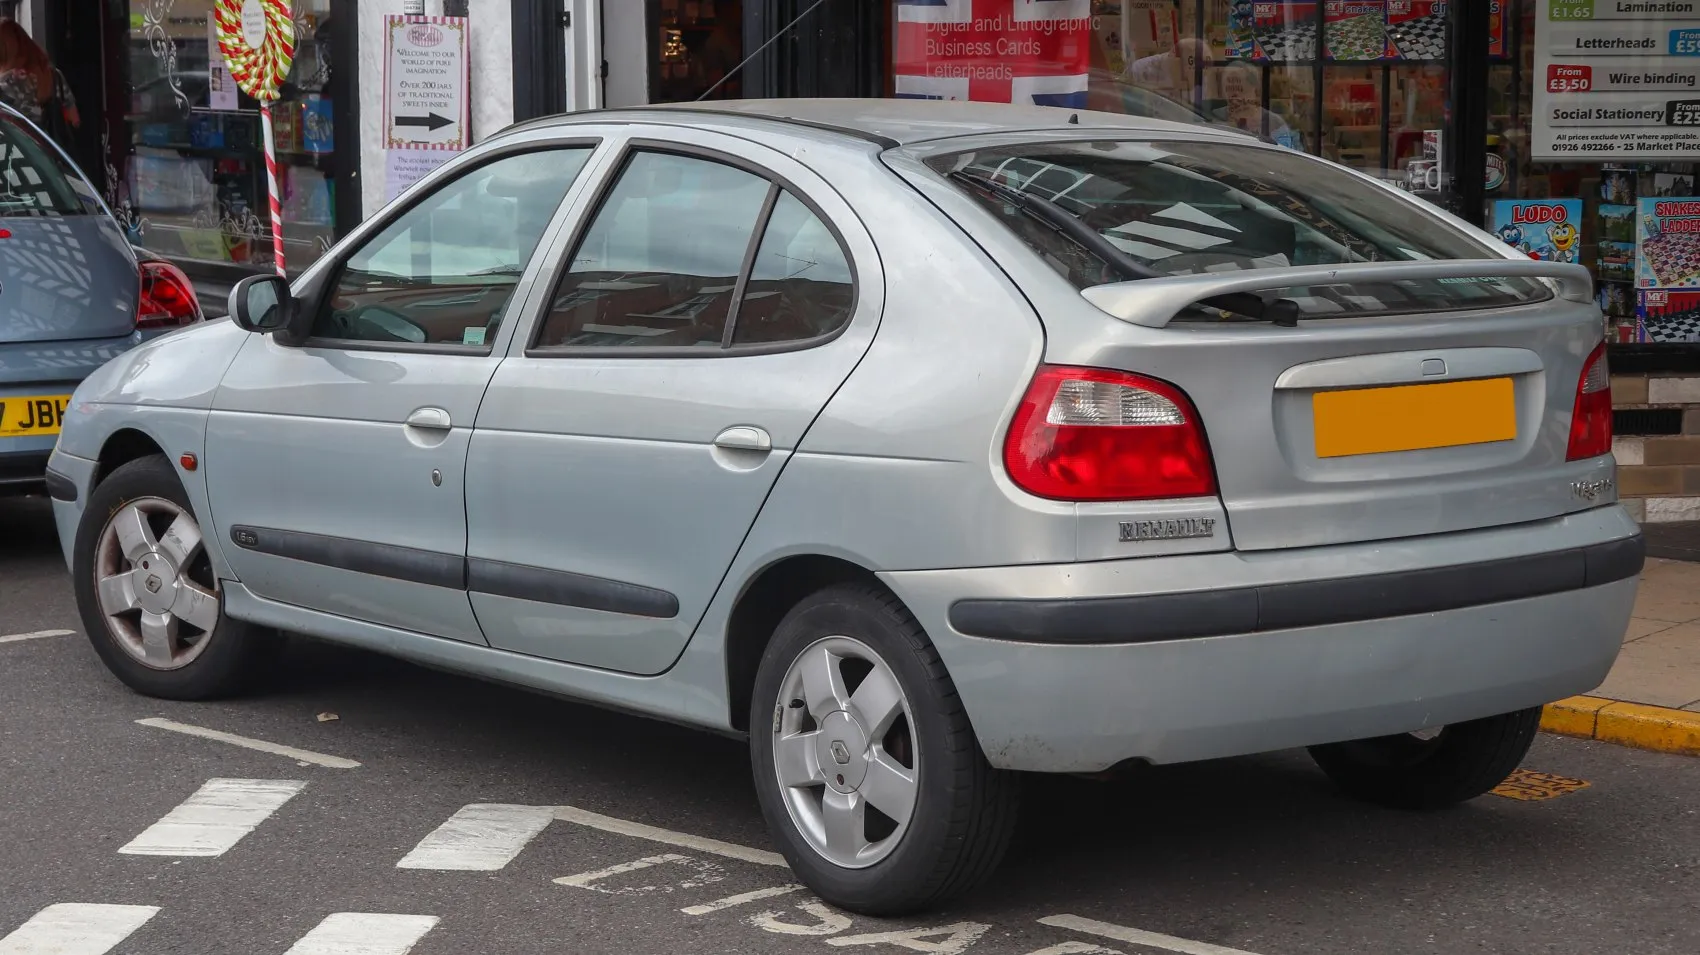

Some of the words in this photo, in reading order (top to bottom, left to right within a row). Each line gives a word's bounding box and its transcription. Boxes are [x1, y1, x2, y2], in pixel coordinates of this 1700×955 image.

[1345, 5, 1380, 14] snakes
[1553, 7, 1590, 18] £1.65
[1616, 1, 1693, 13] Lamination
[925, 16, 970, 36] Digital
[974, 14, 1001, 31] and
[1007, 14, 1101, 35] Lithographic
[925, 38, 991, 56] Business
[996, 37, 1041, 55] Cards
[1576, 37, 1656, 49] Letterheads
[926, 62, 1013, 81] Letterheads
[1557, 68, 1582, 76] From
[421, 81, 436, 89] 200
[1609, 73, 1641, 84] Wire
[1643, 73, 1696, 86] binding
[409, 91, 454, 99] TRADITIONAL
[402, 100, 428, 108] SWEETS
[1676, 103, 1700, 111] From
[1553, 108, 1592, 120] Social
[1595, 108, 1665, 122] Stationery
[1660, 133, 1699, 141] applicable.
[1581, 143, 1615, 151] 492266
[1623, 143, 1634, 151] 25
[1636, 142, 1673, 151] Market
[1512, 204, 1567, 224] LUDO
[1656, 202, 1700, 217] SNAKES
[1119, 518, 1216, 542] RENAULT
